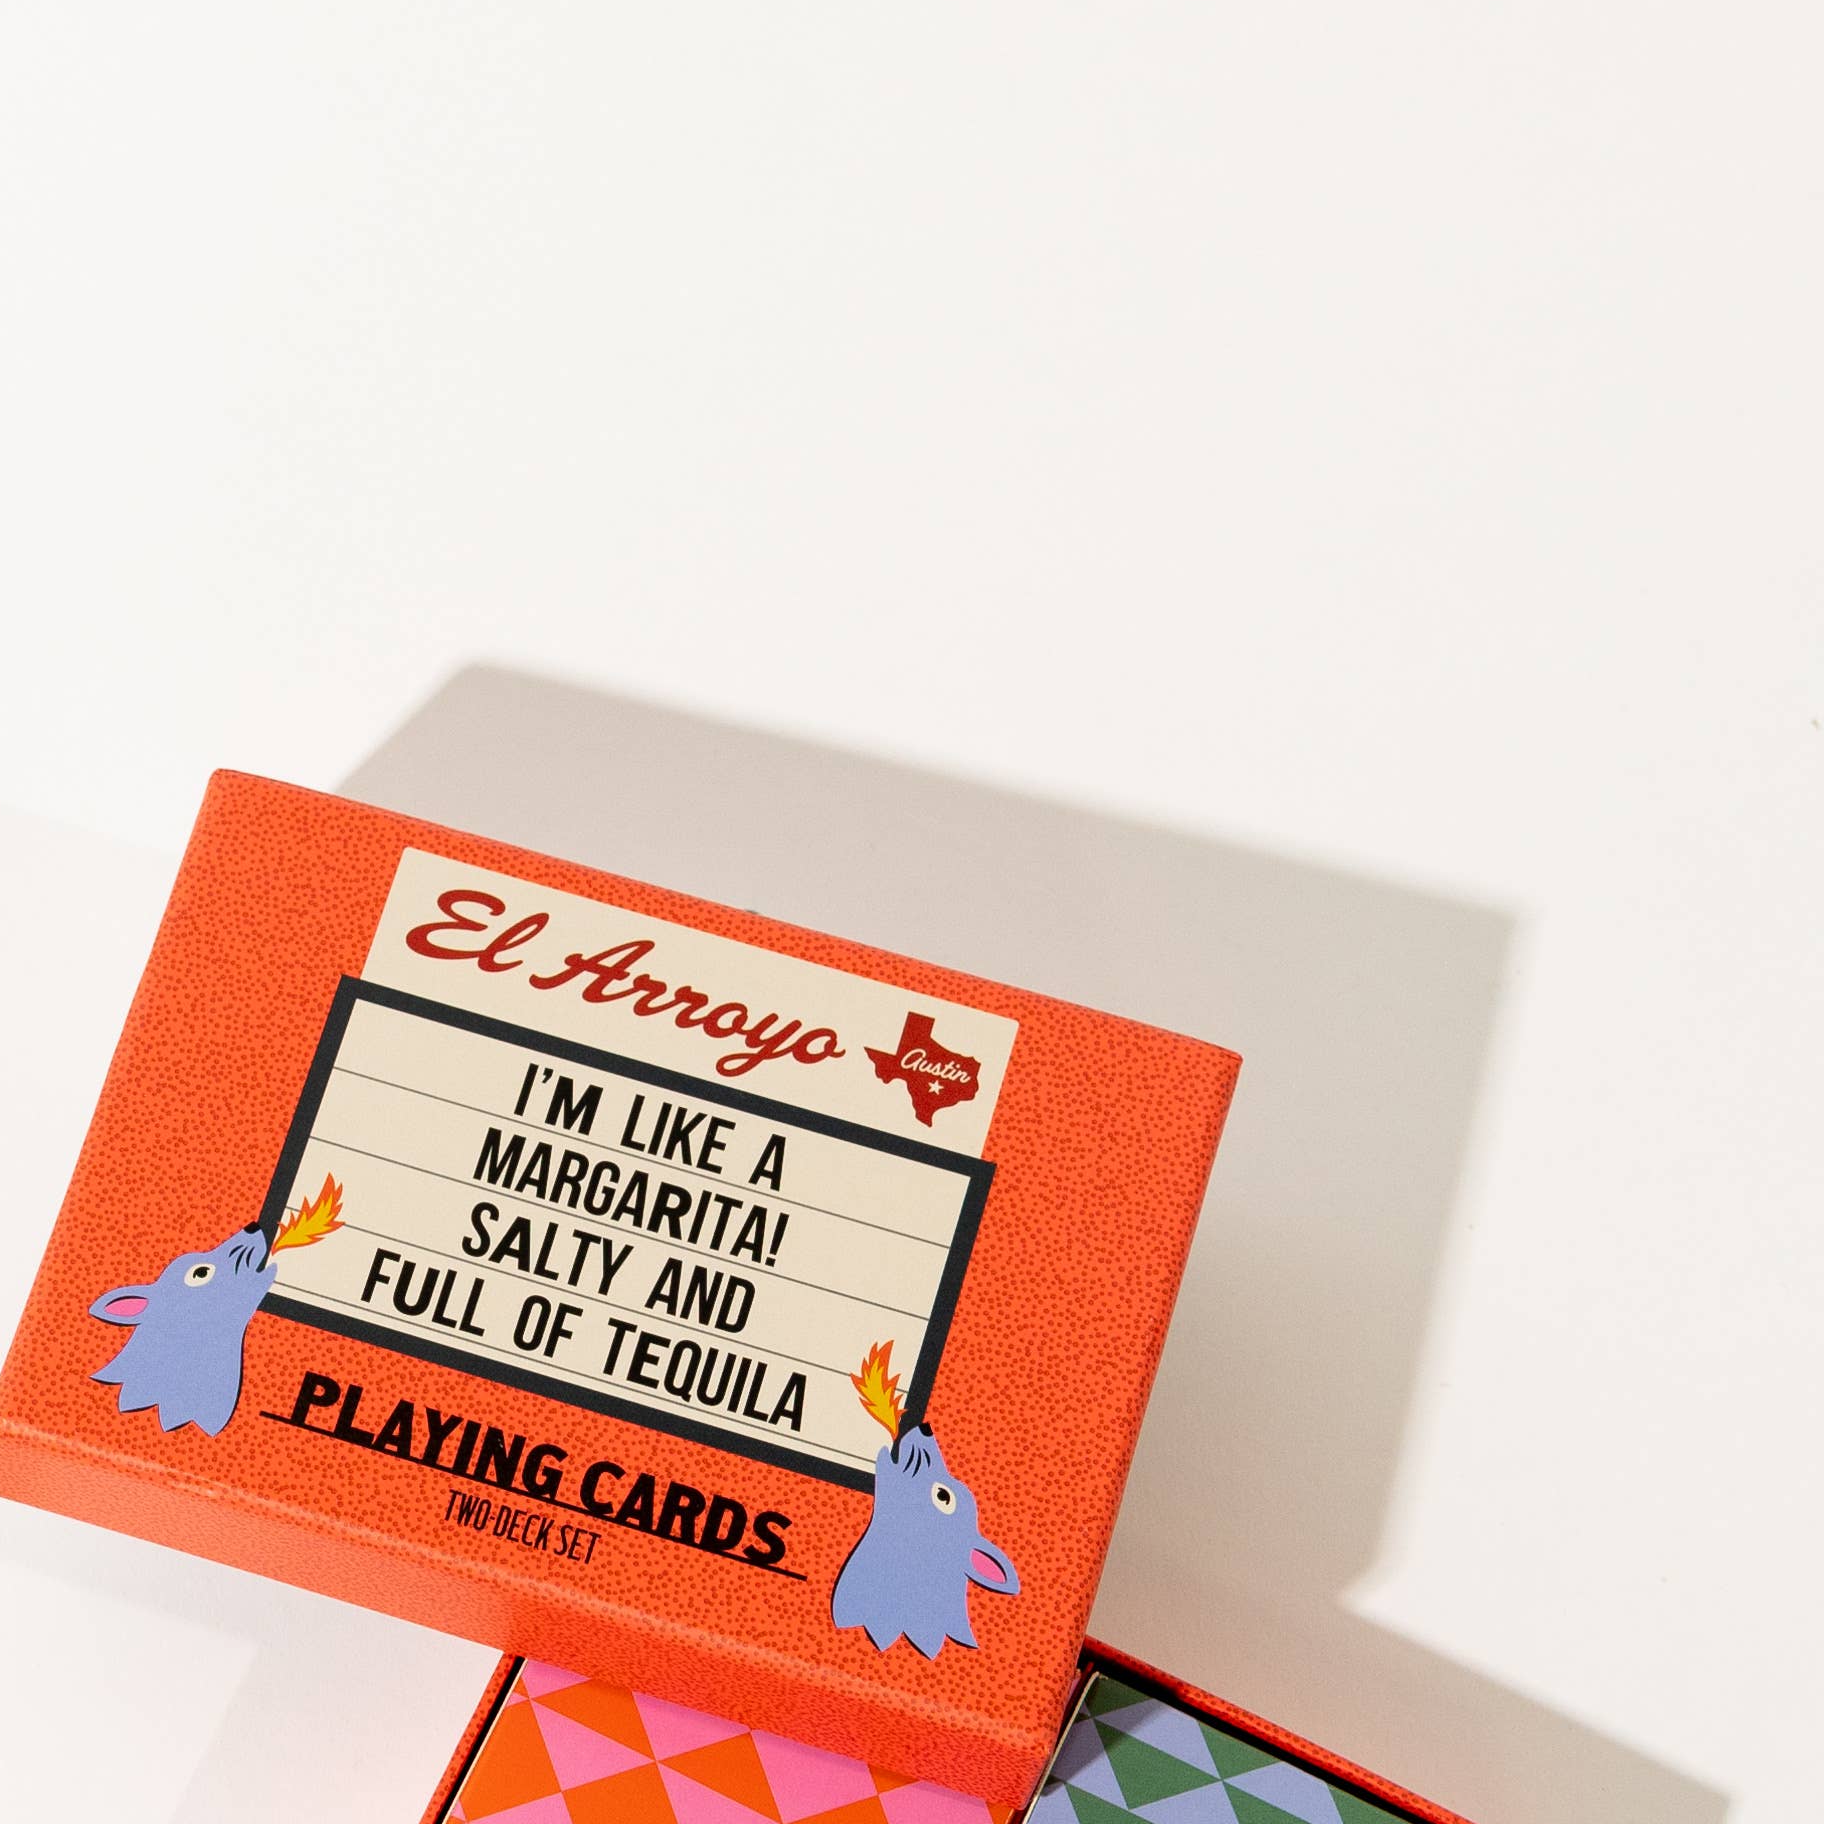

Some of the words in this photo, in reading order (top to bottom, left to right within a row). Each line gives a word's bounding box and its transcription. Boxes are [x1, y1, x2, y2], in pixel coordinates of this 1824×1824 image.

[405, 889, 550, 973] El
[529, 940, 847, 1078] Arroyo
[514, 1063, 604, 1137] I'M
[620, 1094, 737, 1175] LIKE
[749, 1133, 788, 1192] A
[900, 1048, 971, 1084] Austin
[473, 1127, 790, 1268] MARGARITA!
[462, 1201, 634, 1297] SALTY
[645, 1259, 756, 1334] AND
[361, 1248, 486, 1338] FULL
[513, 1293, 584, 1358] OF
[603, 1317, 808, 1433] TEQUILA
[290, 1371, 570, 1500] PLAYING
[580, 1460, 793, 1567] CARDS
[444, 1489, 555, 1550] TWO-DECK
[553, 1526, 602, 1565] SET
